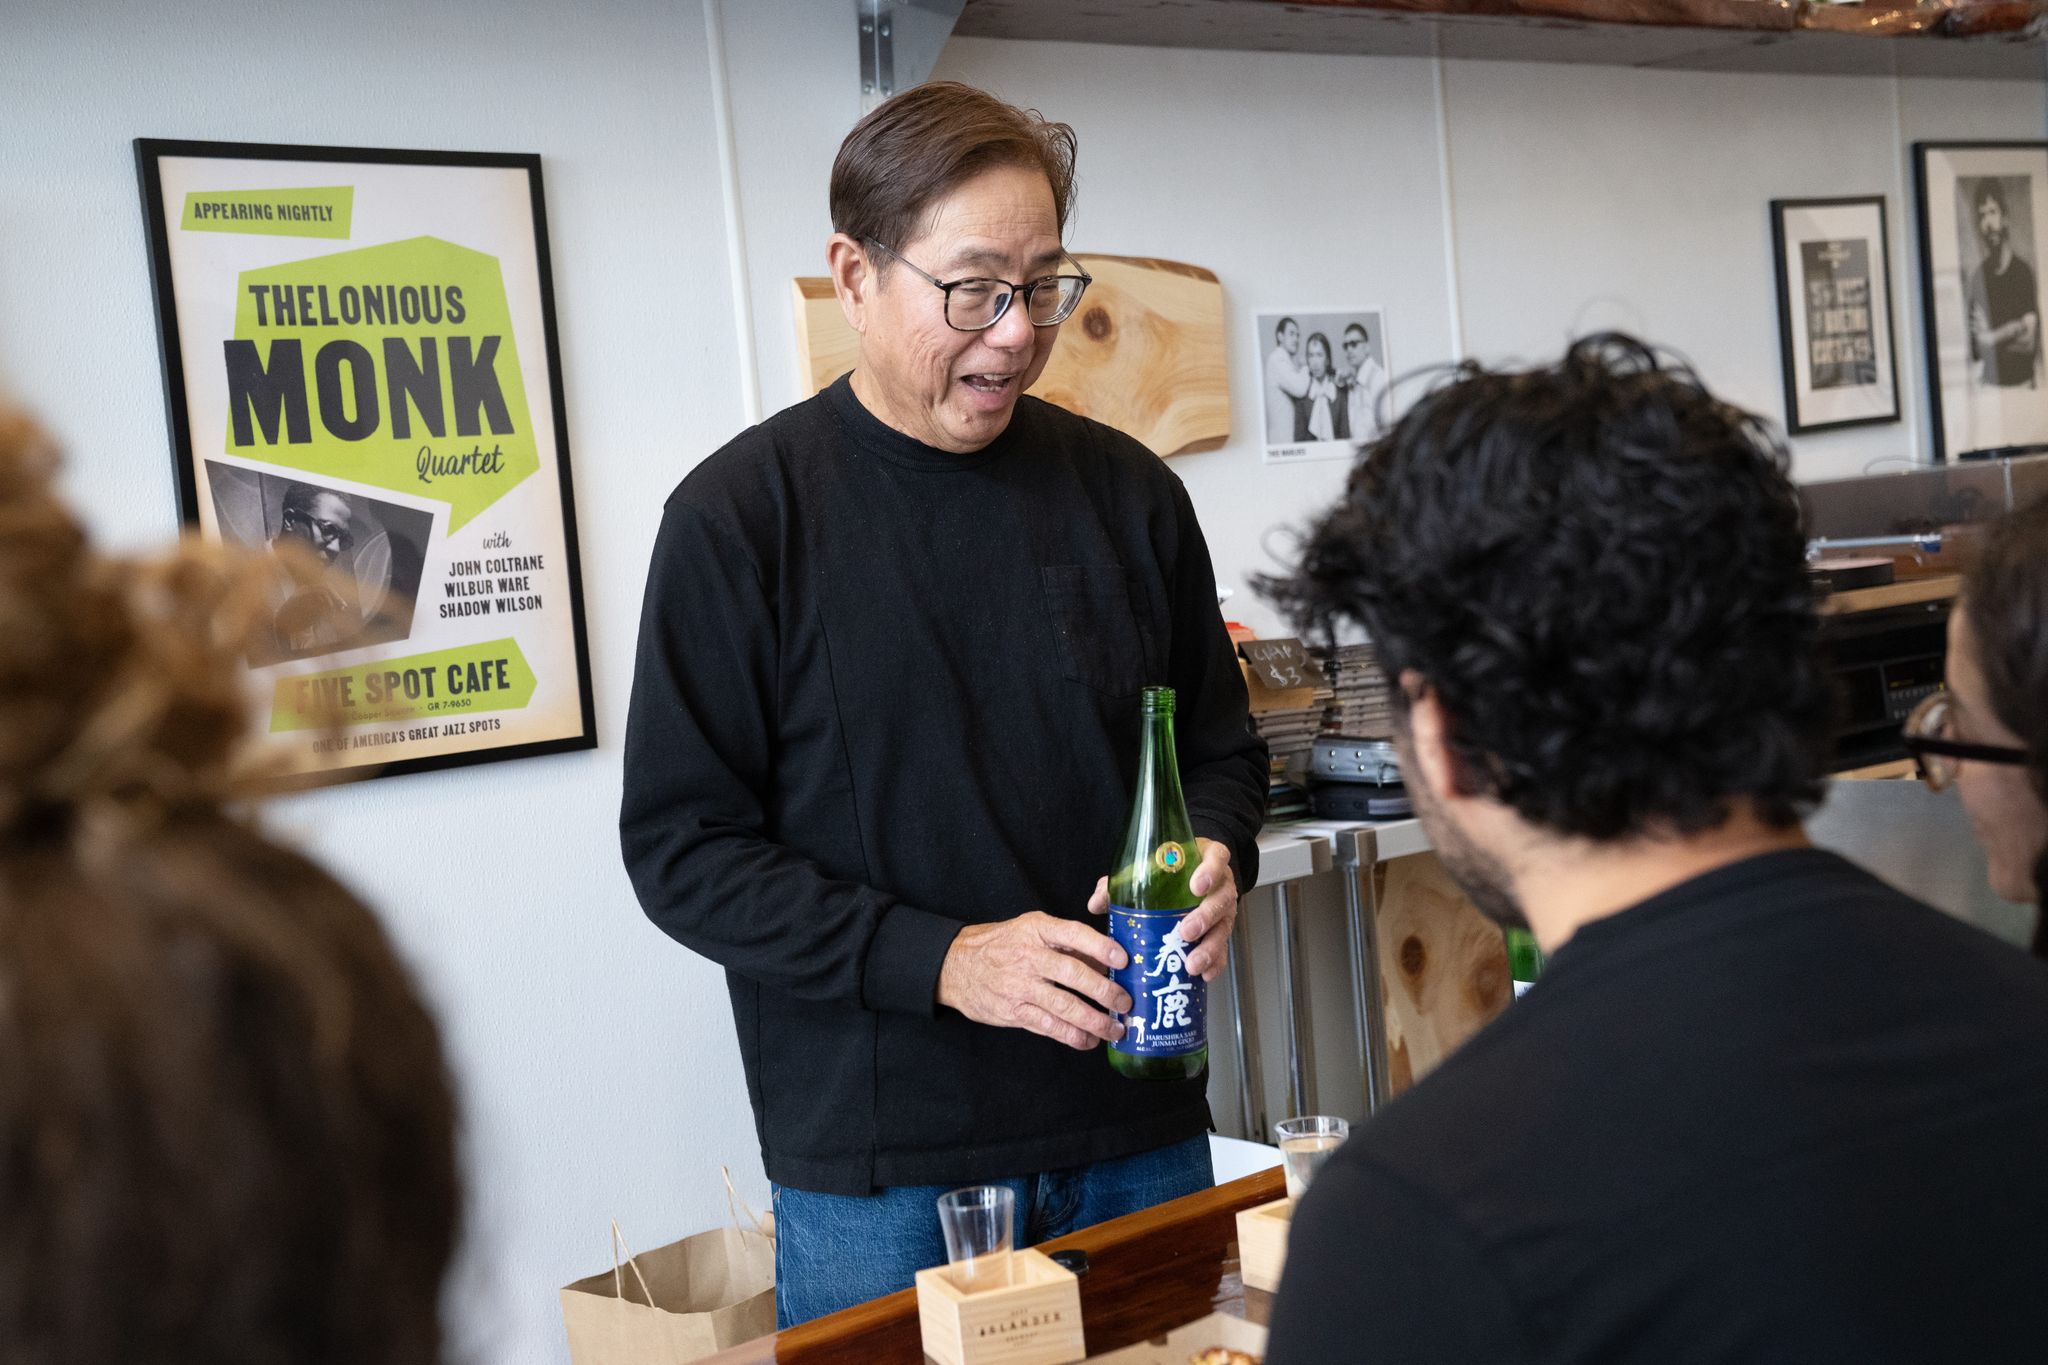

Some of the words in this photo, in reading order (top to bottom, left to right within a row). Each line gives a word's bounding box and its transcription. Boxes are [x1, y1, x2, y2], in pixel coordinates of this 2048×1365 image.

[194, 202, 273, 221] APPEARING
[277, 204, 334, 223] NIGHTLY
[248, 284, 466, 327] THELONIOUS
[223, 335, 515, 447] MONK
[416, 445, 506, 484] Quartet
[483, 530, 512, 549] with
[449, 560, 481, 577] JOHN
[486, 555, 544, 574] COLTRANE
[445, 580, 493, 598] WILBUR
[498, 576, 530, 593] WARE
[440, 600, 490, 618] SHADOW
[496, 595, 543, 613] WILSON
[365, 667, 437, 704] SPOT
[447, 659, 511, 695] CAFE
[428, 702, 440, 711] GR
[353, 730, 406, 748] AMERICA'S
[408, 725, 440, 741] GREAT
[442, 722, 466, 737] JAZZ
[470, 718, 501, 734] SPOTS
[1144, 921, 1193, 1030] 春鹿
